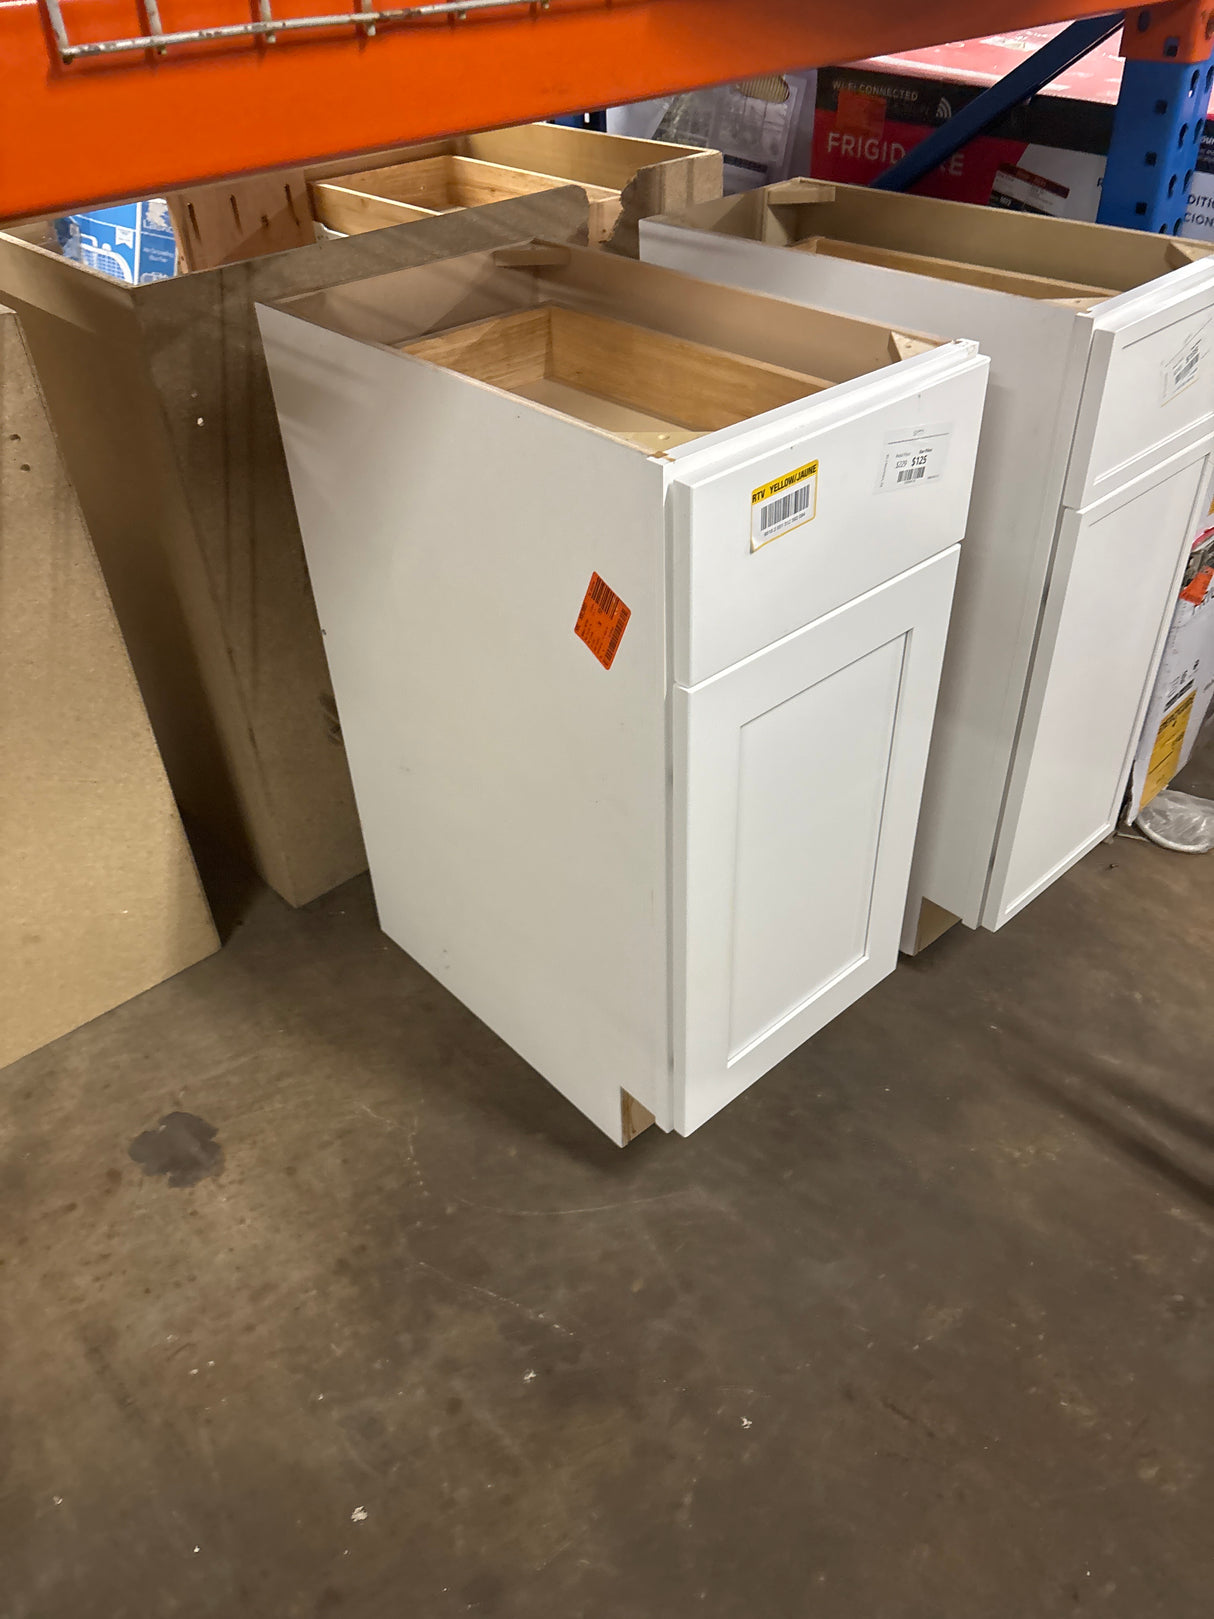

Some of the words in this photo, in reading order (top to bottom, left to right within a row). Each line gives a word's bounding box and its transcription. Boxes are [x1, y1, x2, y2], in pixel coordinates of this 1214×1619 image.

[859, 84, 919, 102] CONNECTED
[827, 131, 965, 177] FRIGIDE
[911, 454, 928, 467] $125
[752, 488, 766, 504] RTV
[769, 464, 817, 494] YELLOW/JAUNE
